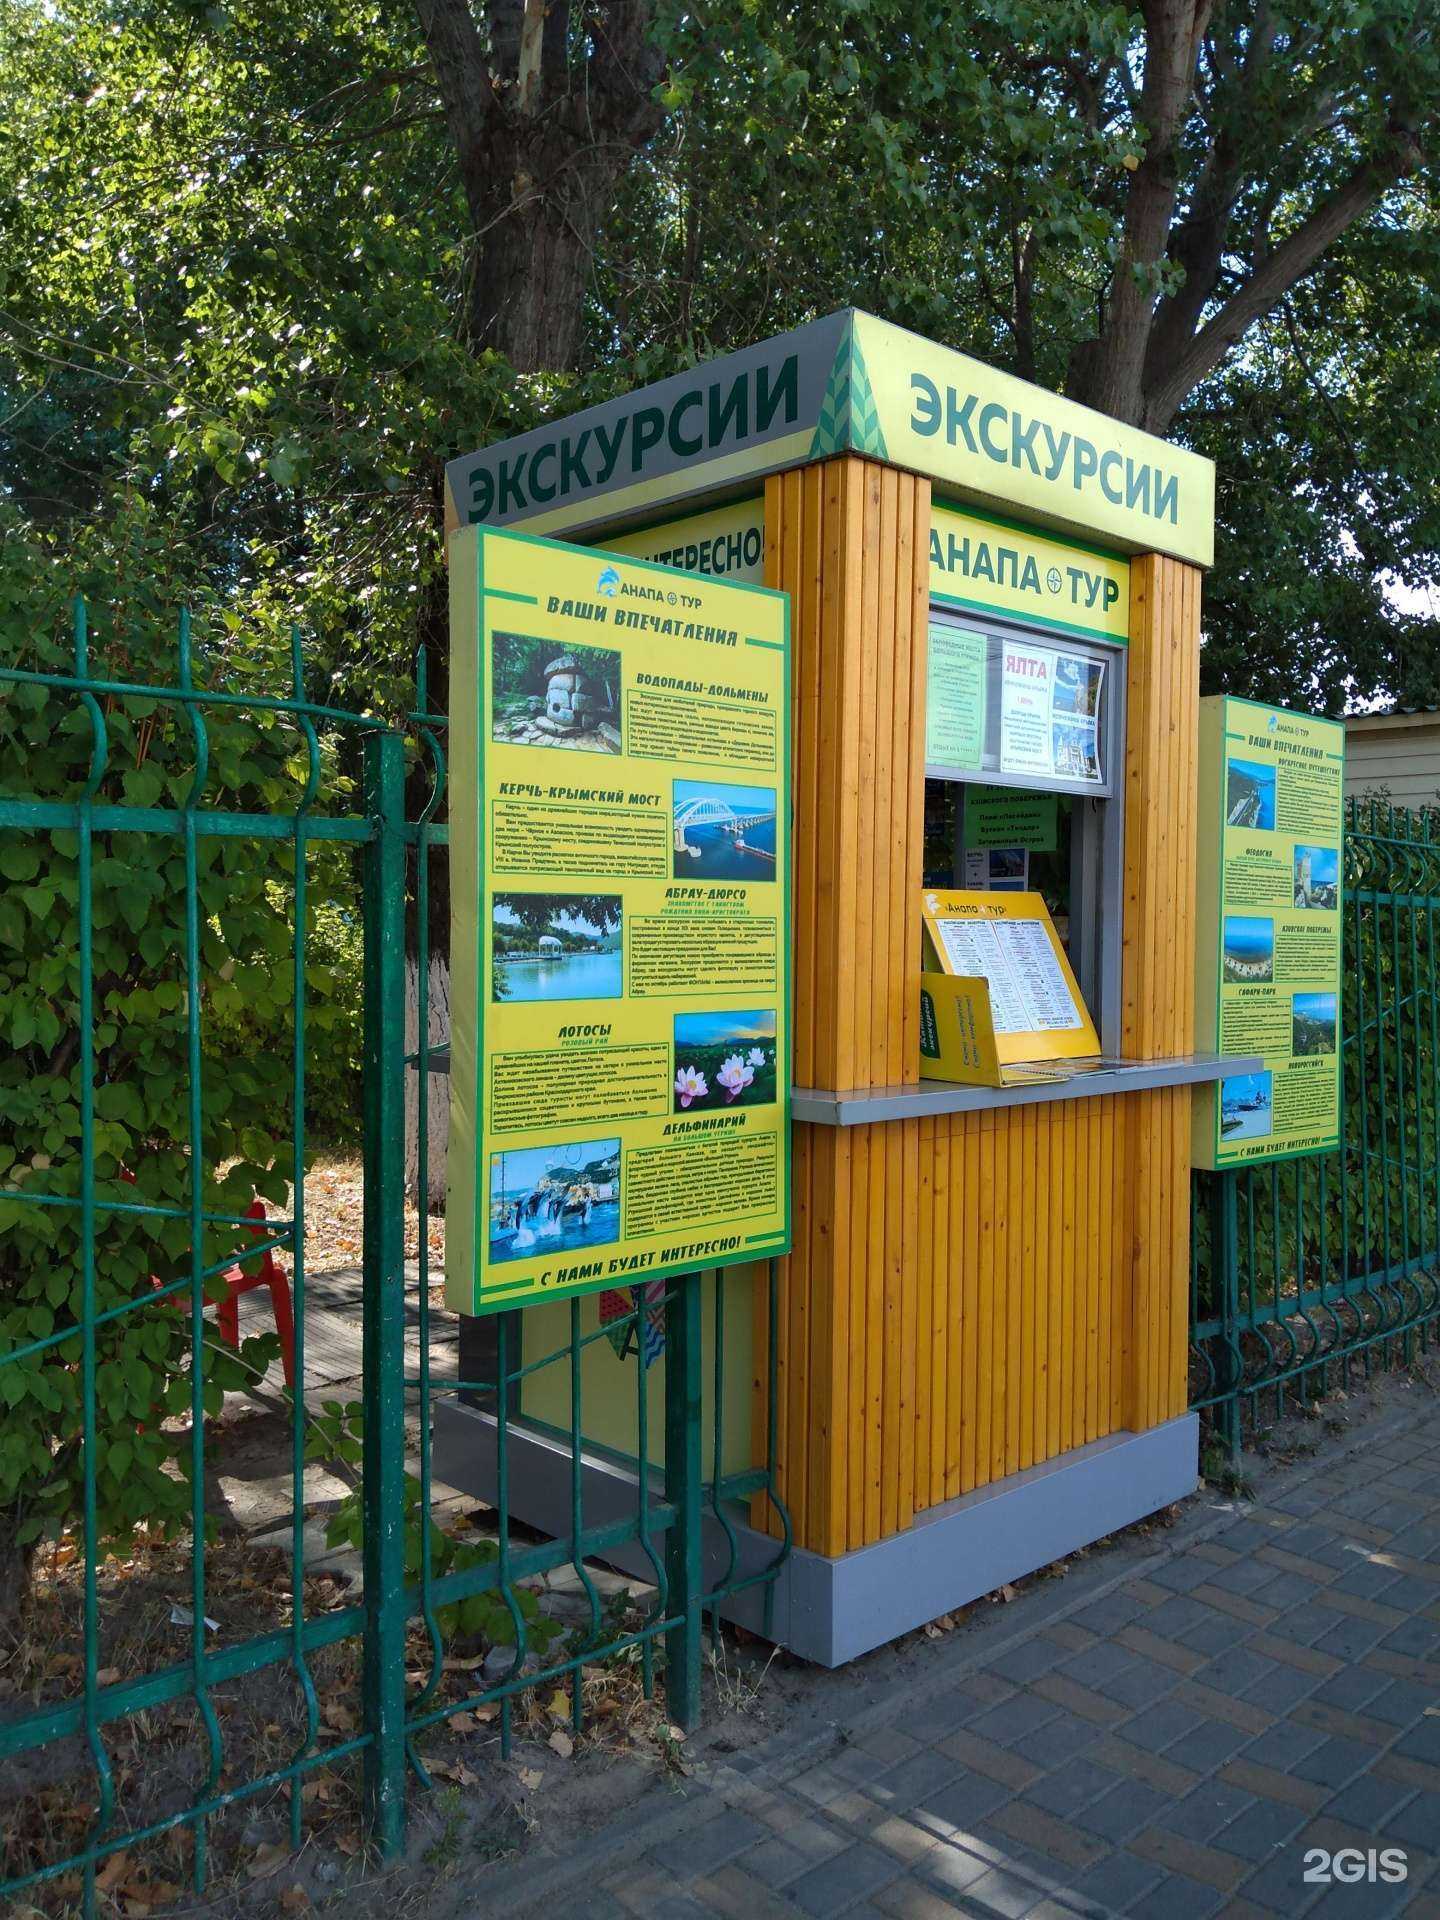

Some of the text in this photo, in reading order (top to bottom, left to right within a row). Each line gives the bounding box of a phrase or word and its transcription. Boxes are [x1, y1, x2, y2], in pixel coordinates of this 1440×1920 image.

[468, 355, 798, 524] ЭКСКУРСИИ
[911, 373, 1179, 525] ЭКСКУРСИИ
[929, 528, 1119, 612] АНАПА ТУР
[620, 583, 702, 609] АНАПА ТУР
[547, 596, 738, 647] ВАШИ ВПЕЧАТЛЕНИЯ
[1006, 655, 1047, 679] ЯЛТА
[636, 673, 769, 703] ВОДОПАДЫ-ДОЛЬМЕНЫ
[1249, 735, 1324, 760] ВАШИ ВПЕЧАТЛЕНИЯ
[499, 782, 661, 806] КЕРЧЬ-КРЫМСКИЙ МОСТ
[665, 887, 746, 900] АБРАУ-ДЮРСО
[558, 1023, 612, 1038] ЛОТОСЫ
[662, 1113, 746, 1136] ДЕЛЬФИНАРИЙ
[540, 1235, 742, 1286] С НАМИ БУДЕТ ИНТЕРЕСНО!
